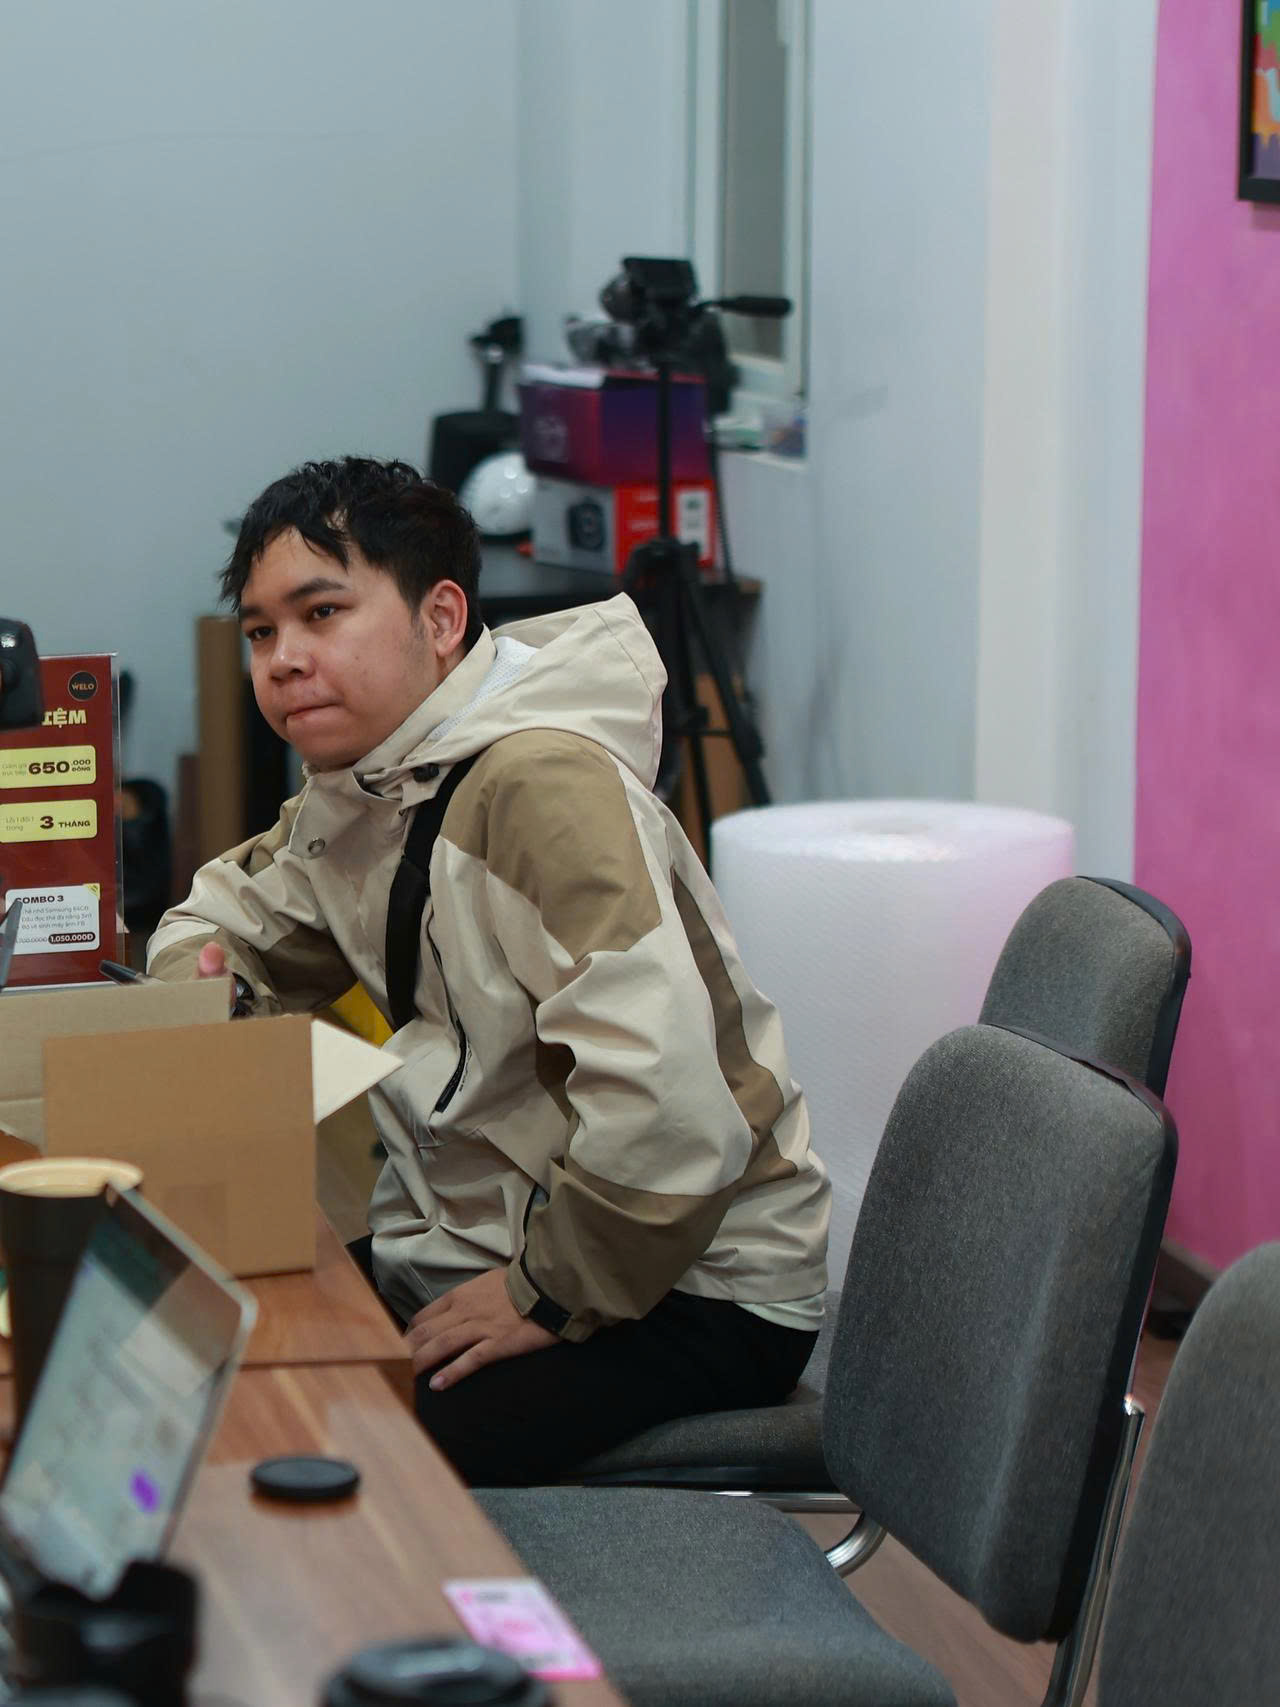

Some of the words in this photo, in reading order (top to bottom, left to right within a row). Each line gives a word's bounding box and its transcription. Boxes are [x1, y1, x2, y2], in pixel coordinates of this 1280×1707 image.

[71, 682, 95, 691] WELO
[41, 707, 87, 729] IỆM
[28, 760, 70, 775] 650
[40, 815, 54, 829] 3
[58, 819, 91, 829] THÁNG
[50, 933, 94, 943] 1.050.000Đ
